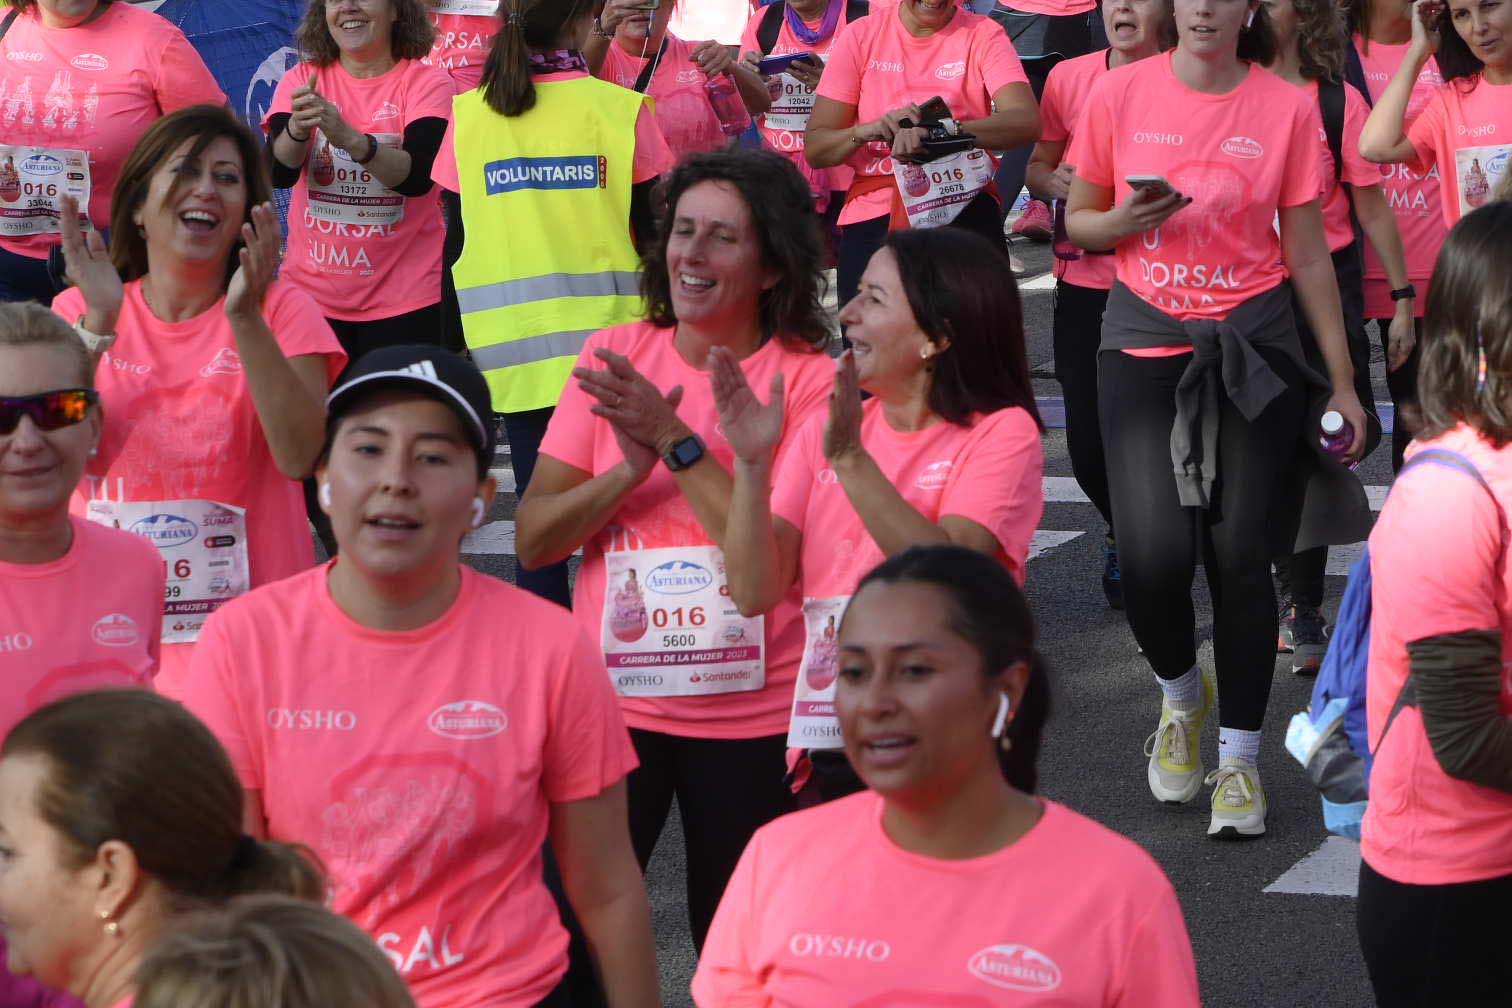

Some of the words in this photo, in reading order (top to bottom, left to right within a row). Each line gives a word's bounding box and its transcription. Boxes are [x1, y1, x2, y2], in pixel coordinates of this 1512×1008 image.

[1458, 123, 1496, 138] OYSHO
[1134, 131, 1183, 146] OYSHO
[337, 168, 371, 183] 016
[487, 164, 595, 187] VOLUNTARIS
[932, 168, 964, 184] 016
[24, 182, 57, 197] 016
[340, 185, 367, 195] 13172
[652, 574, 708, 588] ASTURIANA
[175, 602, 209, 612] MUJER
[652, 606, 706, 628] 016
[663, 633, 696, 648] 5600
[619, 653, 662, 665] CARRERA
[663, 653, 676, 663] DE
[678, 653, 690, 662] LA
[691, 652, 724, 662] MUJER
[618, 673, 664, 687] OYSHO
[702, 669, 752, 683] Santander
[267, 707, 357, 731] OYSHO
[789, 931, 892, 963] OYSHO
[975, 957, 1055, 986] ASTURIANA
